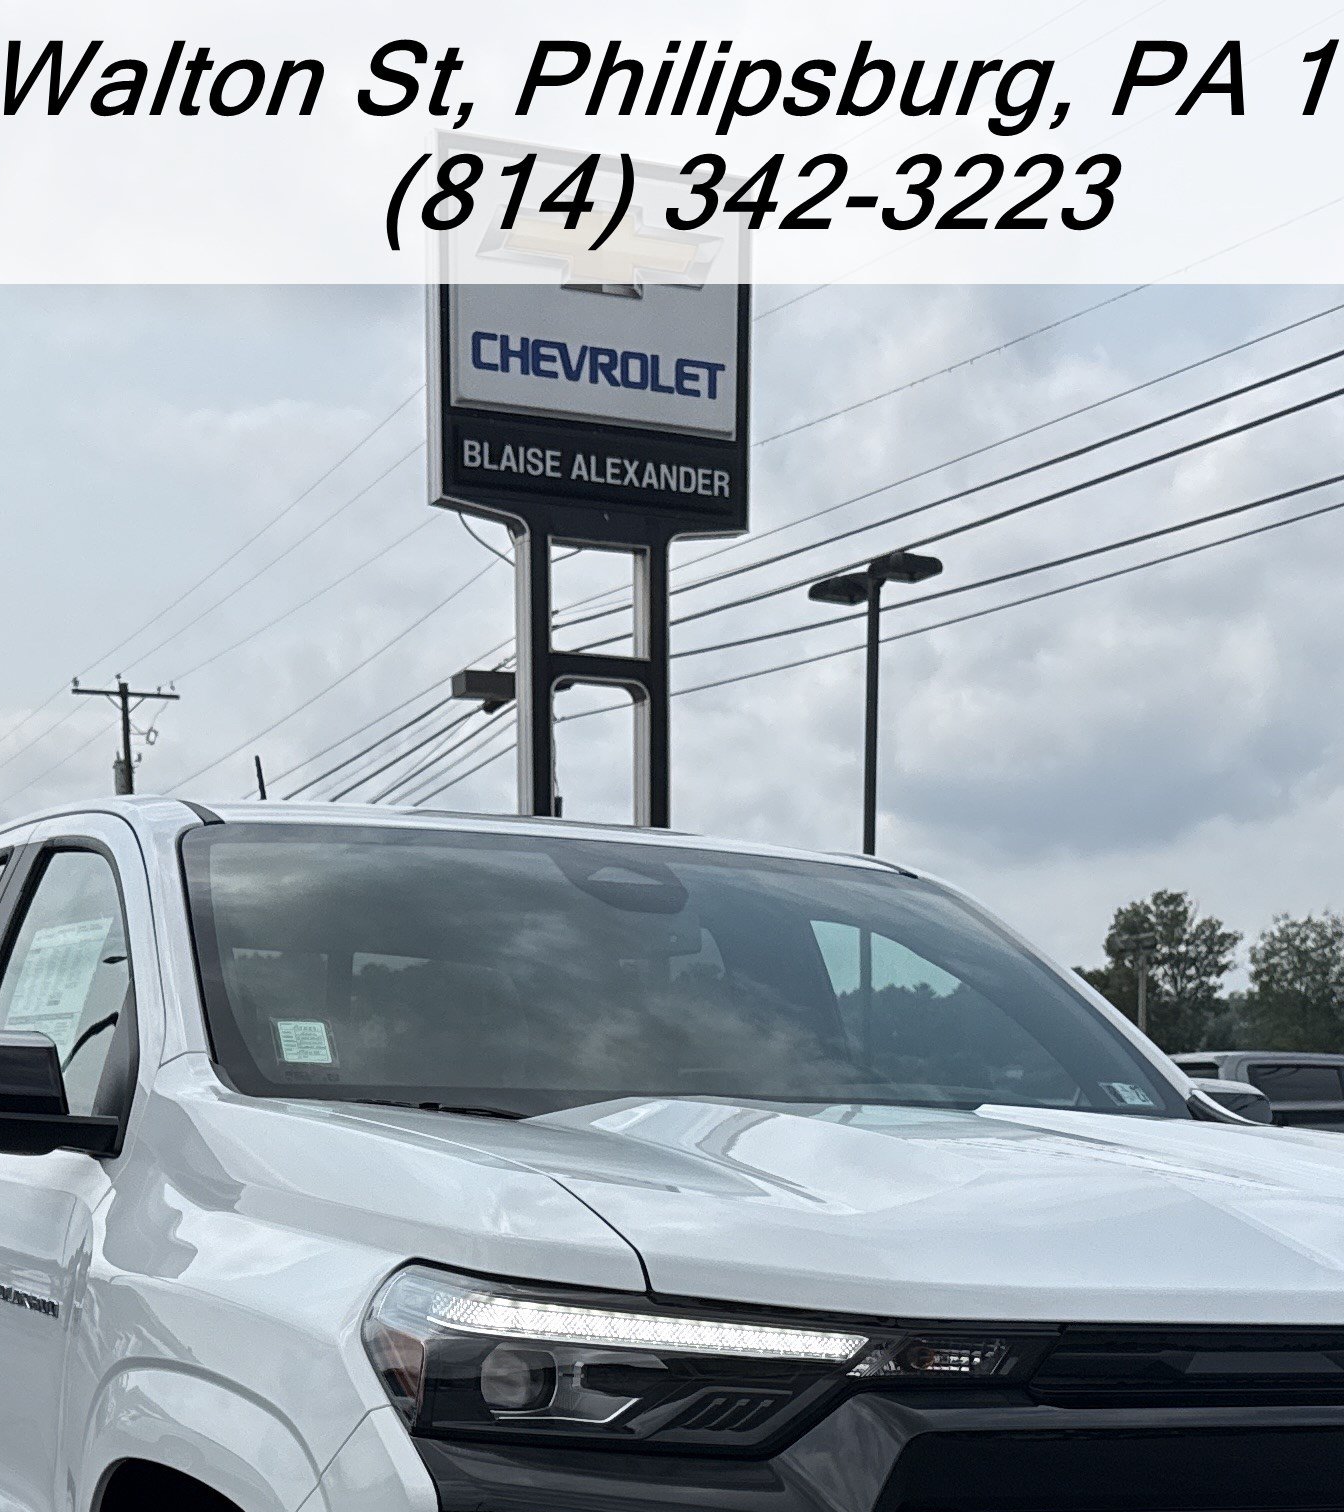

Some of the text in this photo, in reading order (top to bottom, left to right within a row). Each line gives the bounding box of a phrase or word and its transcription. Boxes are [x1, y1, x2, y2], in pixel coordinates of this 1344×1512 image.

[470, 330, 726, 400] CHEVROLET
[462, 439, 730, 498] BLAISE ALEXANDER
